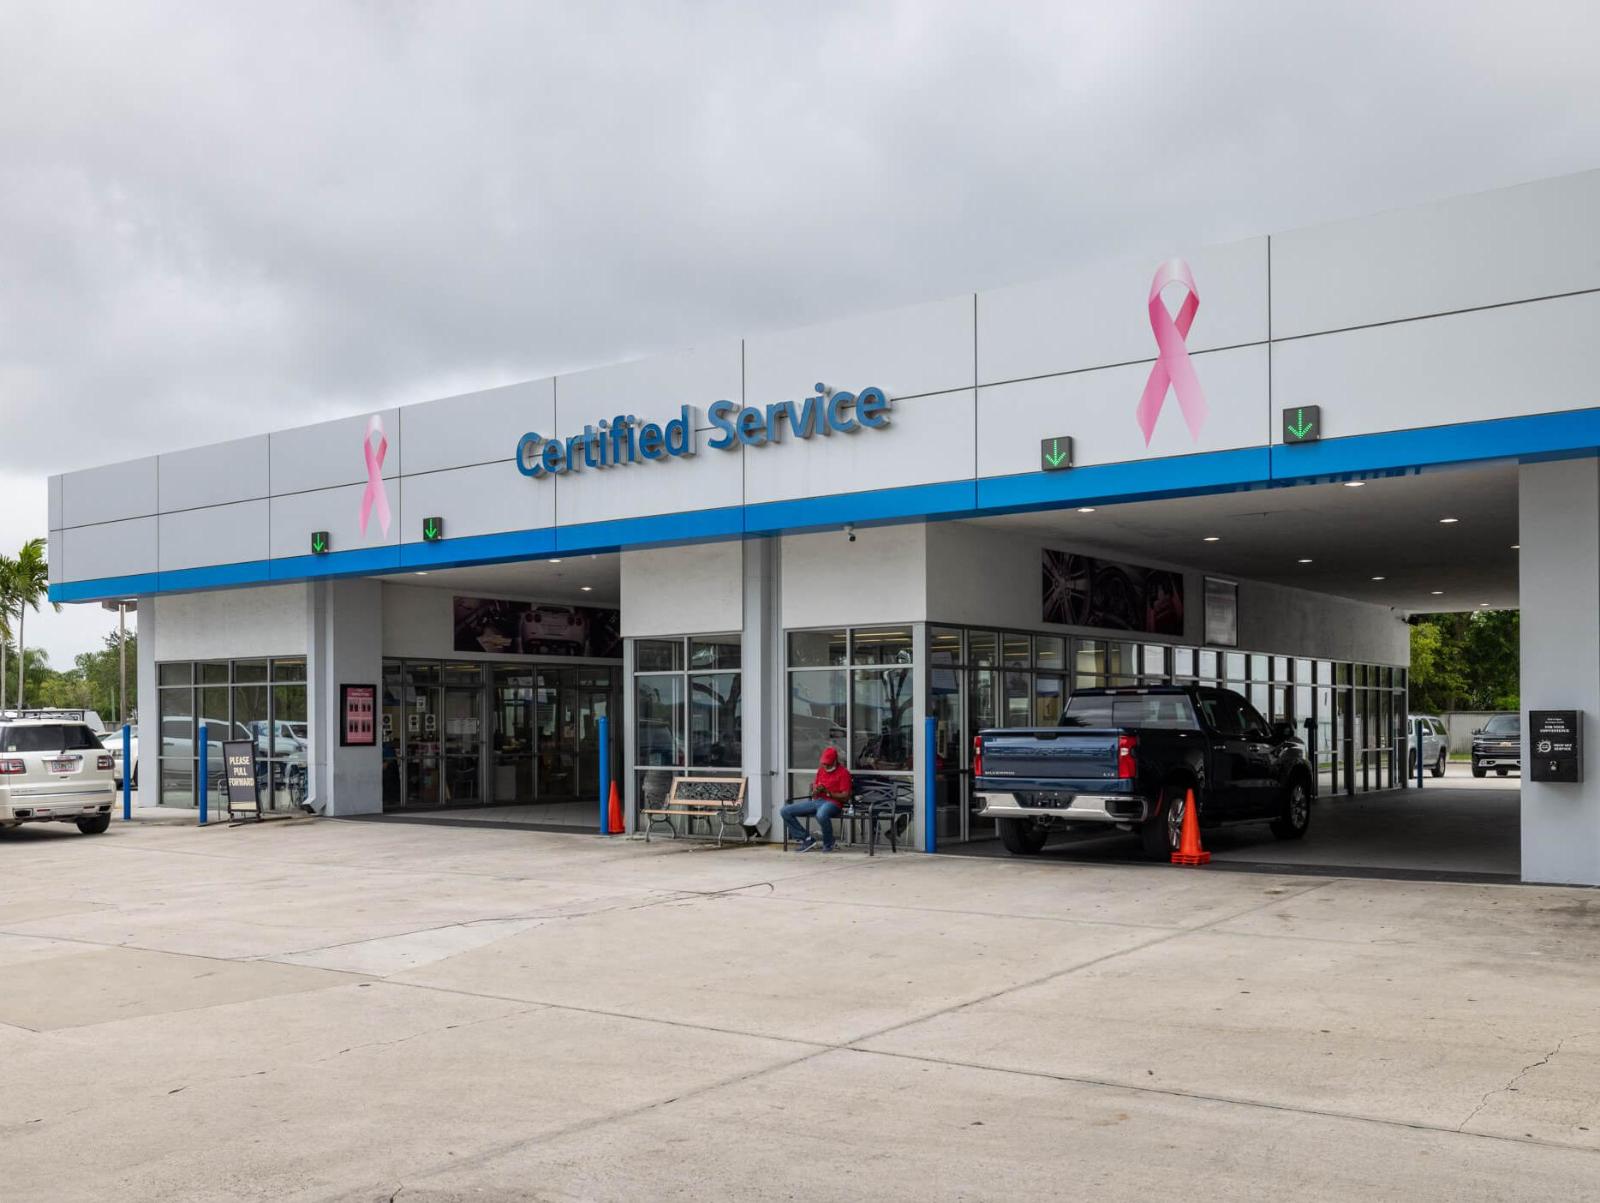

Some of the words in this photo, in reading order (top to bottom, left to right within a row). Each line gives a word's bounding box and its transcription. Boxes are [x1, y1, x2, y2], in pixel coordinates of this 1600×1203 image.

[515, 405, 695, 477] Certified
[708, 382, 889, 449] Service
[229, 756, 250, 765] PLEASE
[233, 767, 248, 776] PULL
[228, 778, 254, 786] FORWARD
